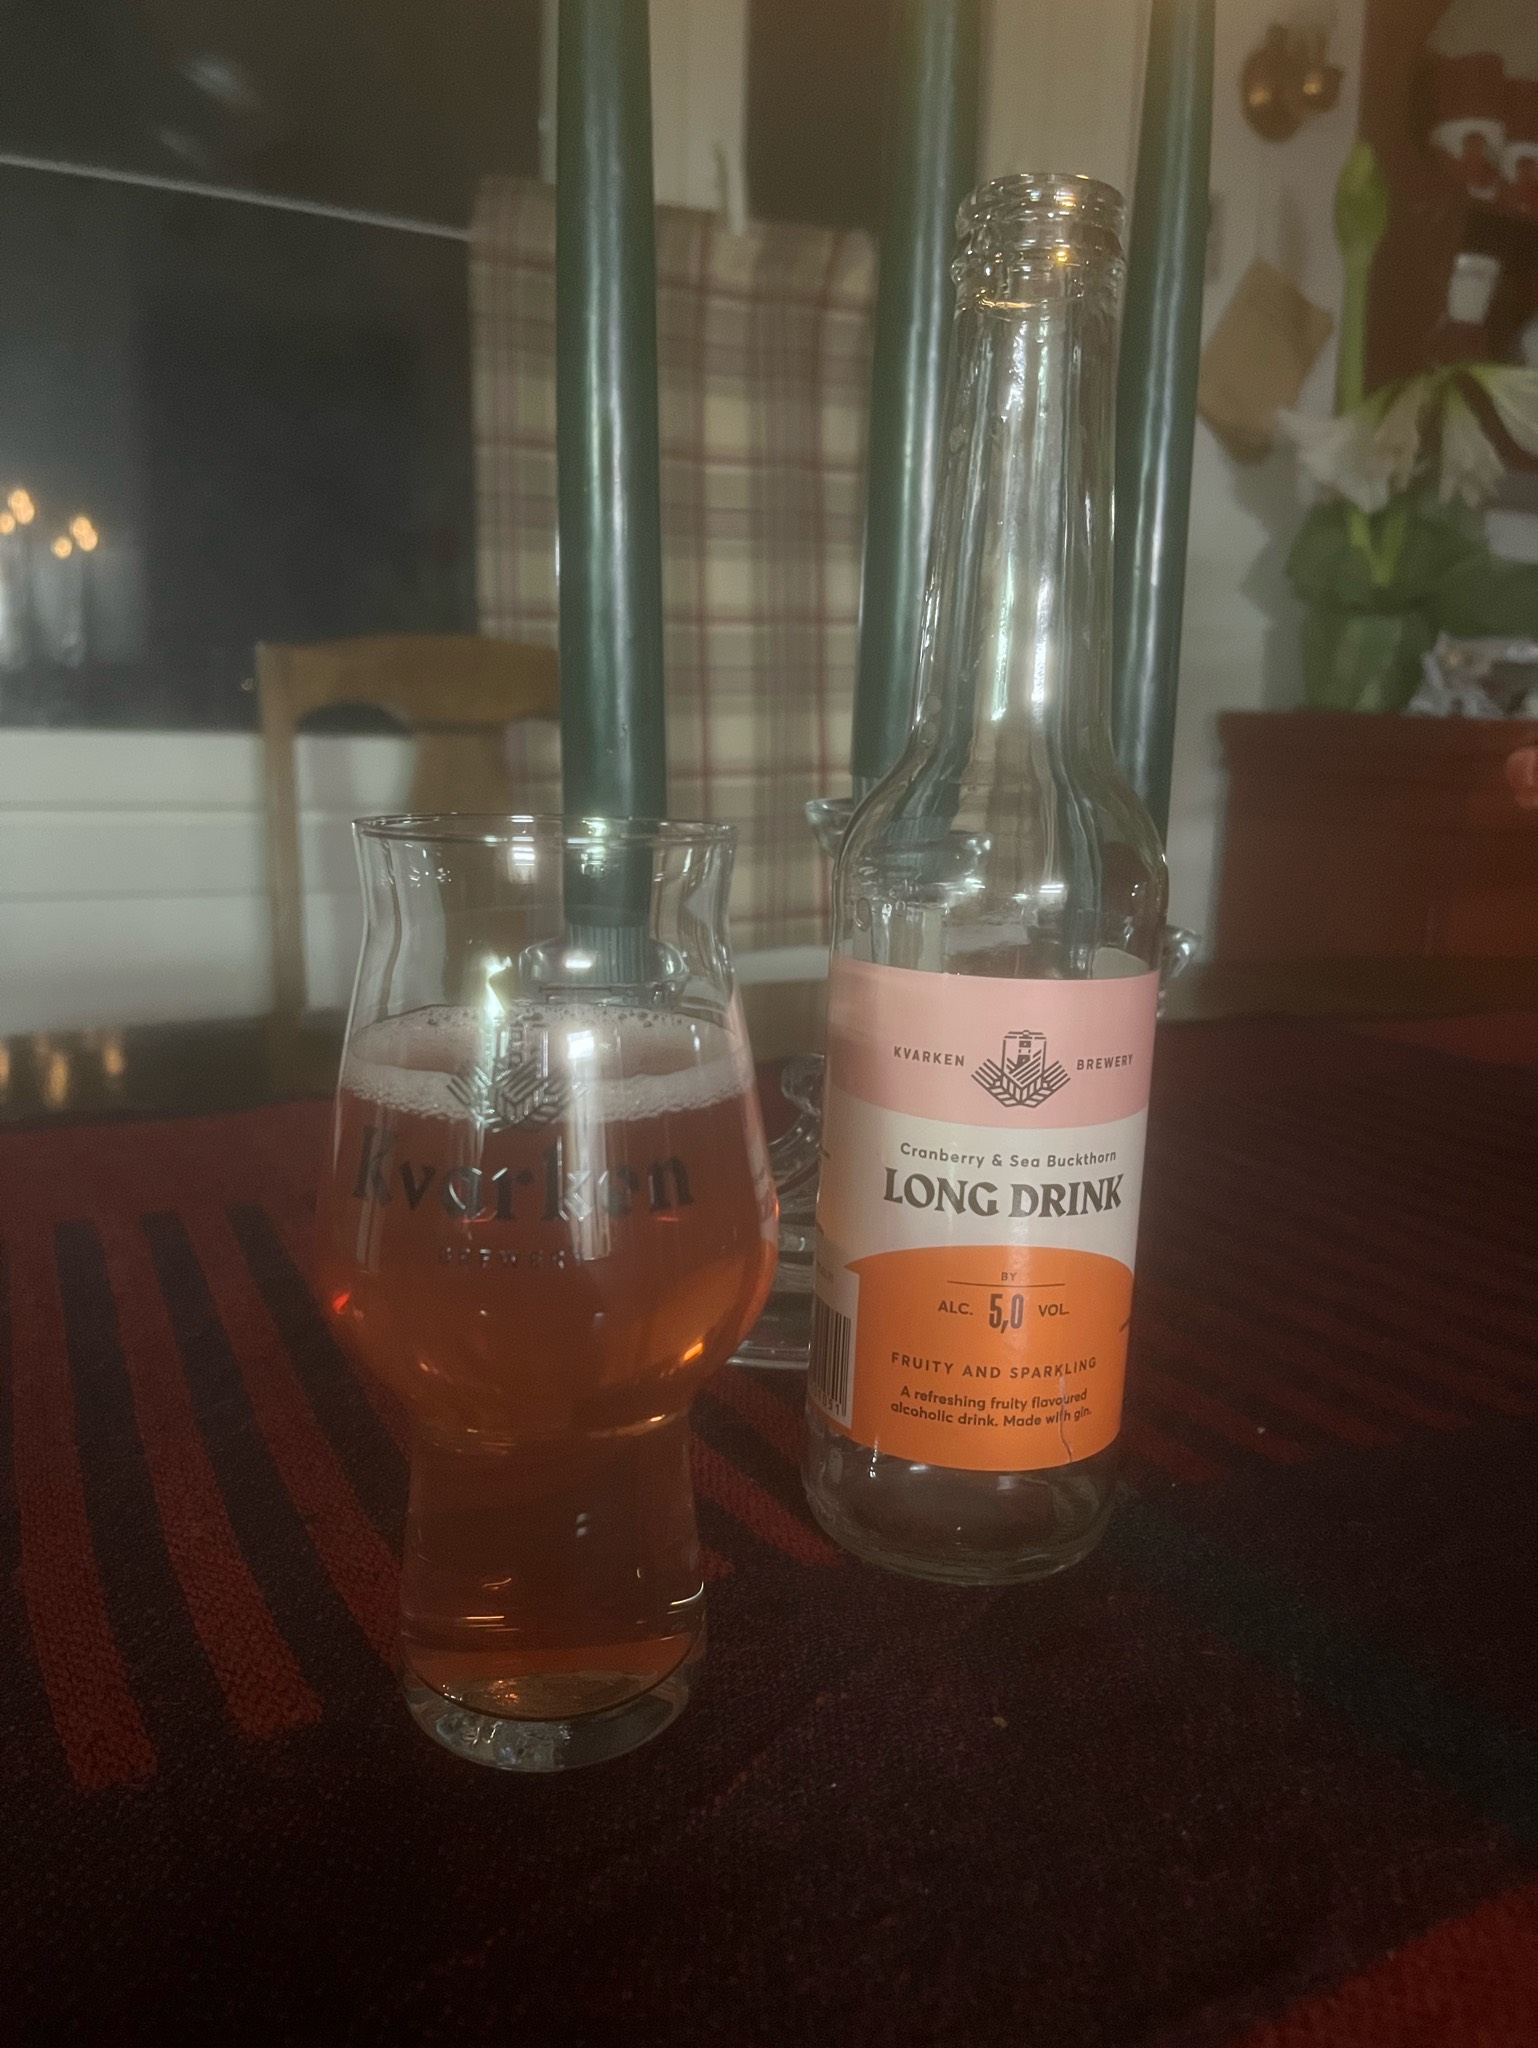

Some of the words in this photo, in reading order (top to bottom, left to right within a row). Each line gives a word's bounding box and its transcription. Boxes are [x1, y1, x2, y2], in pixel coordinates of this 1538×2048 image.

[893, 1046, 965, 1067] KVARKEN
[1077, 1053, 1134, 1070] BREWERY
[900, 1142, 985, 1169] Cranberry
[992, 1154, 1003, 1167] &
[1009, 1154, 1040, 1168] Sea
[1047, 1150, 1117, 1168] Buckthorn
[883, 1166, 999, 1217] LONG
[1008, 1173, 1124, 1218] DRINK
[1001, 1272, 1017, 1281] BY
[938, 1300, 973, 1316] ALC.
[989, 1293, 1024, 1334] 5,0
[891, 1352, 954, 1375] FRUITY
[962, 1365, 1001, 1379] AND
[1009, 1356, 1097, 1379] SPARKLING
[900, 1385, 911, 1399] A
[914, 1388, 986, 1411] refreshing
[990, 1397, 1028, 1412] fruity
[1031, 1388, 1088, 1410] flavoured
[890, 1401, 953, 1424] alcoholic
[957, 1412, 999, 1427] drink.
[1003, 1414, 1042, 1427] Made
[1045, 1410, 1071, 1424] with
[1073, 1406, 1093, 1422] gin.
